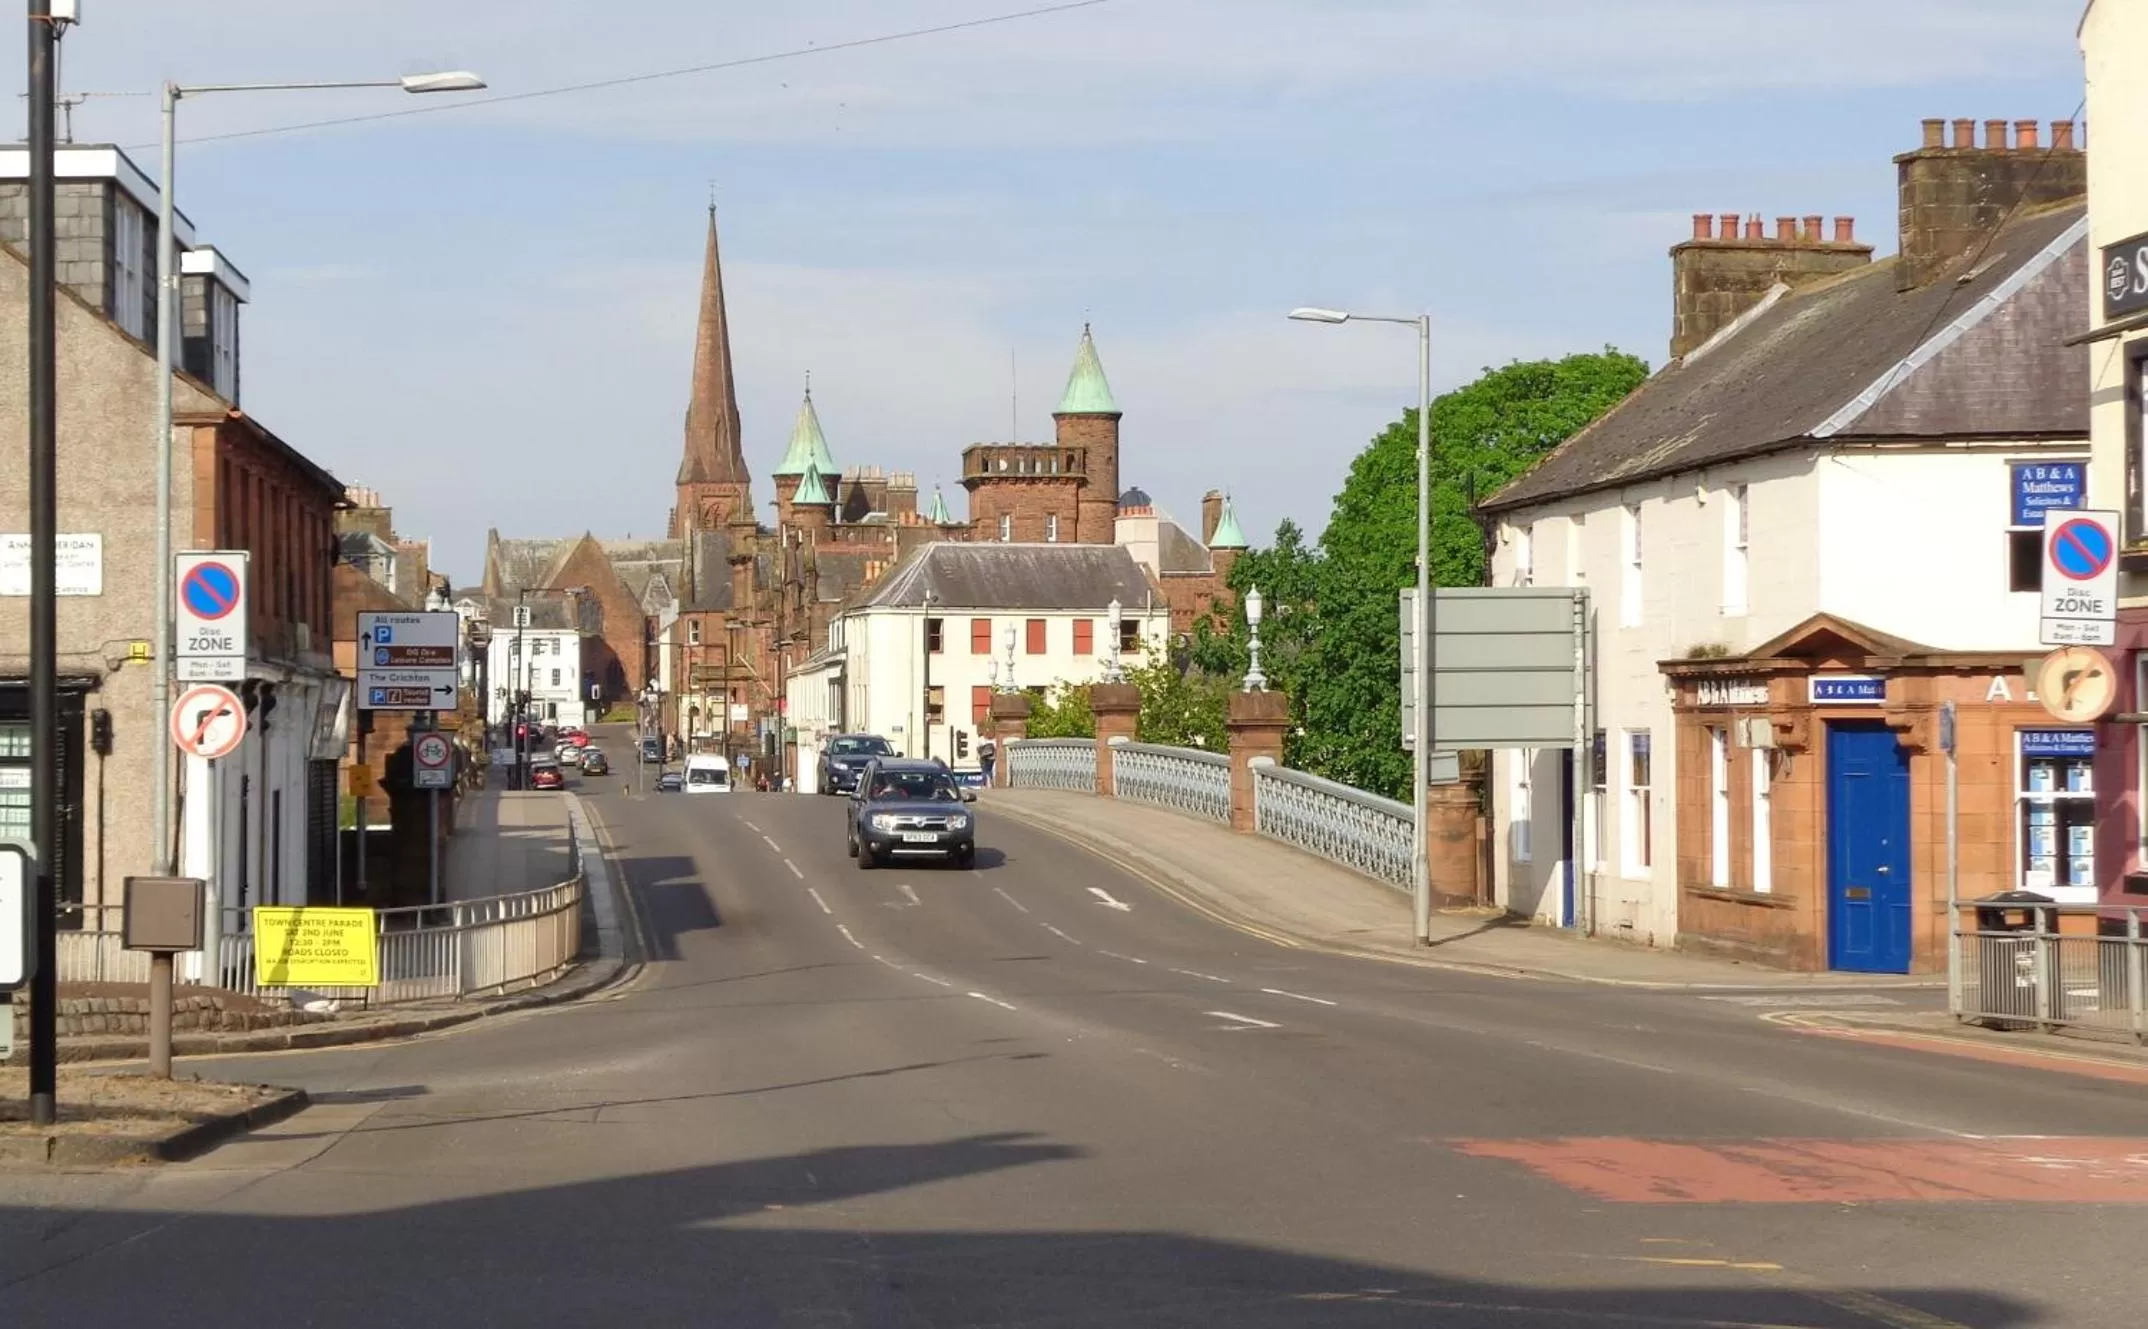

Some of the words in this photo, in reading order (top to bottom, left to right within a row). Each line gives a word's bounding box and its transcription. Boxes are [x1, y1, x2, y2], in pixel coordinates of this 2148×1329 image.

[2022, 468, 2032, 480] A
[2036, 467, 2045, 480] B
[2049, 467, 2060, 479] &
[2064, 467, 2074, 479] A
[2022, 481, 2074, 494] Matthews
[2055, 598, 2103, 613] ZONE
[189, 637, 232, 650] ZONE
[1986, 676, 2013, 702] A
[264, 919, 291, 927] TOWN
[292, 919, 326, 927] CENTRE
[328, 920, 363, 928] PARADE
[302, 929, 320, 937] 2ND
[323, 929, 344, 937] JUNE
[314, 949, 349, 957] CLOSED
